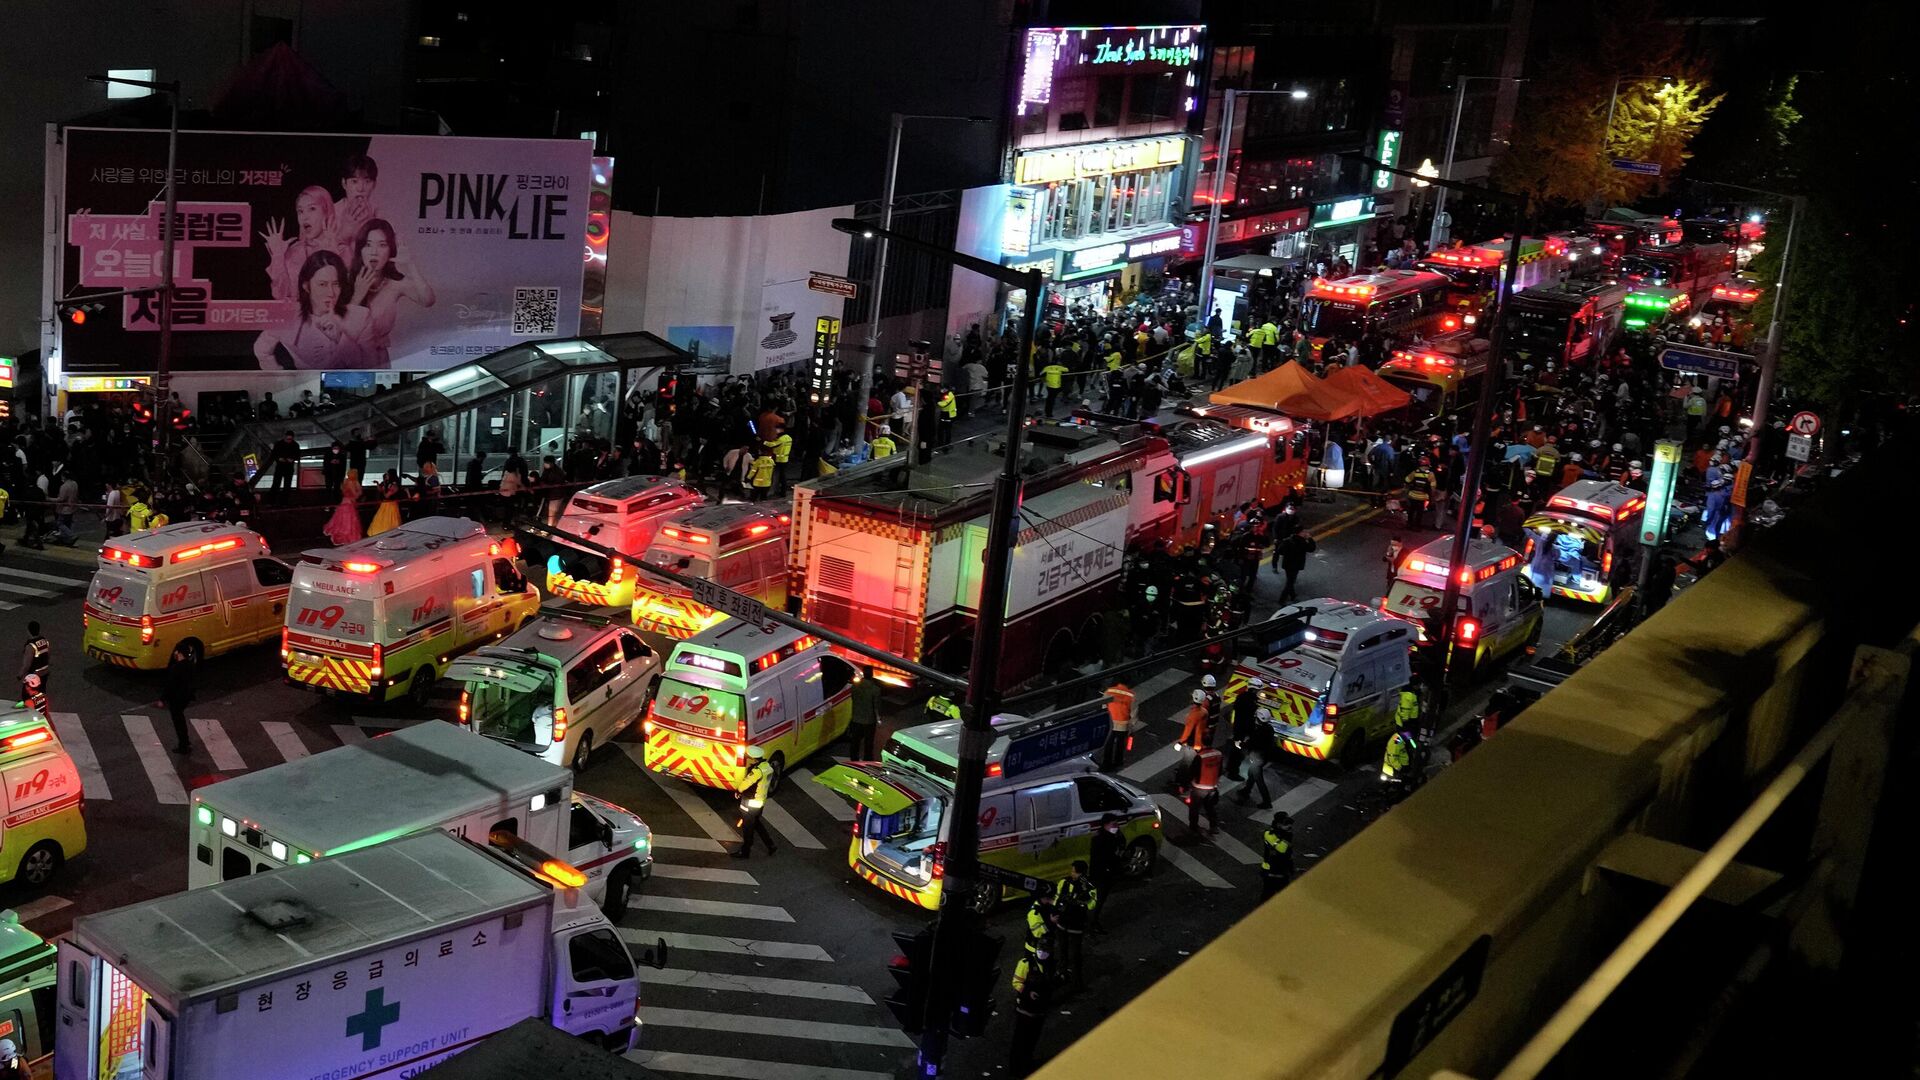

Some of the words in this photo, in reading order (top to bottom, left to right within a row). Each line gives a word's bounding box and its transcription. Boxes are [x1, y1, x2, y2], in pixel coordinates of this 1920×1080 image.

[90, 167, 134, 184] 사랑을
[191, 169, 235, 185] 하나의
[239, 170, 283, 186] 거짓말
[516, 174, 570, 190] 핑크라이
[418, 172, 509, 221] PINK
[89, 223, 106, 240] 저
[158, 212, 243, 242] 클럽은
[508, 194, 568, 240] LIE
[93, 249, 180, 279] 오늘이
[1038, 541, 1116, 597] 긴급구조통제단
[162, 585, 188, 608] 119
[313, 581, 356, 595] AMBULANCE
[695, 580, 715, 604] 직진
[719, 590, 728, 608] 후
[731, 596, 763, 625] 좌회전
[296, 605, 345, 631] 119
[340, 621, 366, 636] 구급대
[311, 637, 347, 649] AMBULANCE
[665, 694, 710, 715] 119
[1039, 727, 1078, 751] 이태원로
[15, 769, 50, 802] 119
[379, 1038, 437, 1065] SUPPORT
[440, 1026, 471, 1046] UNIT
